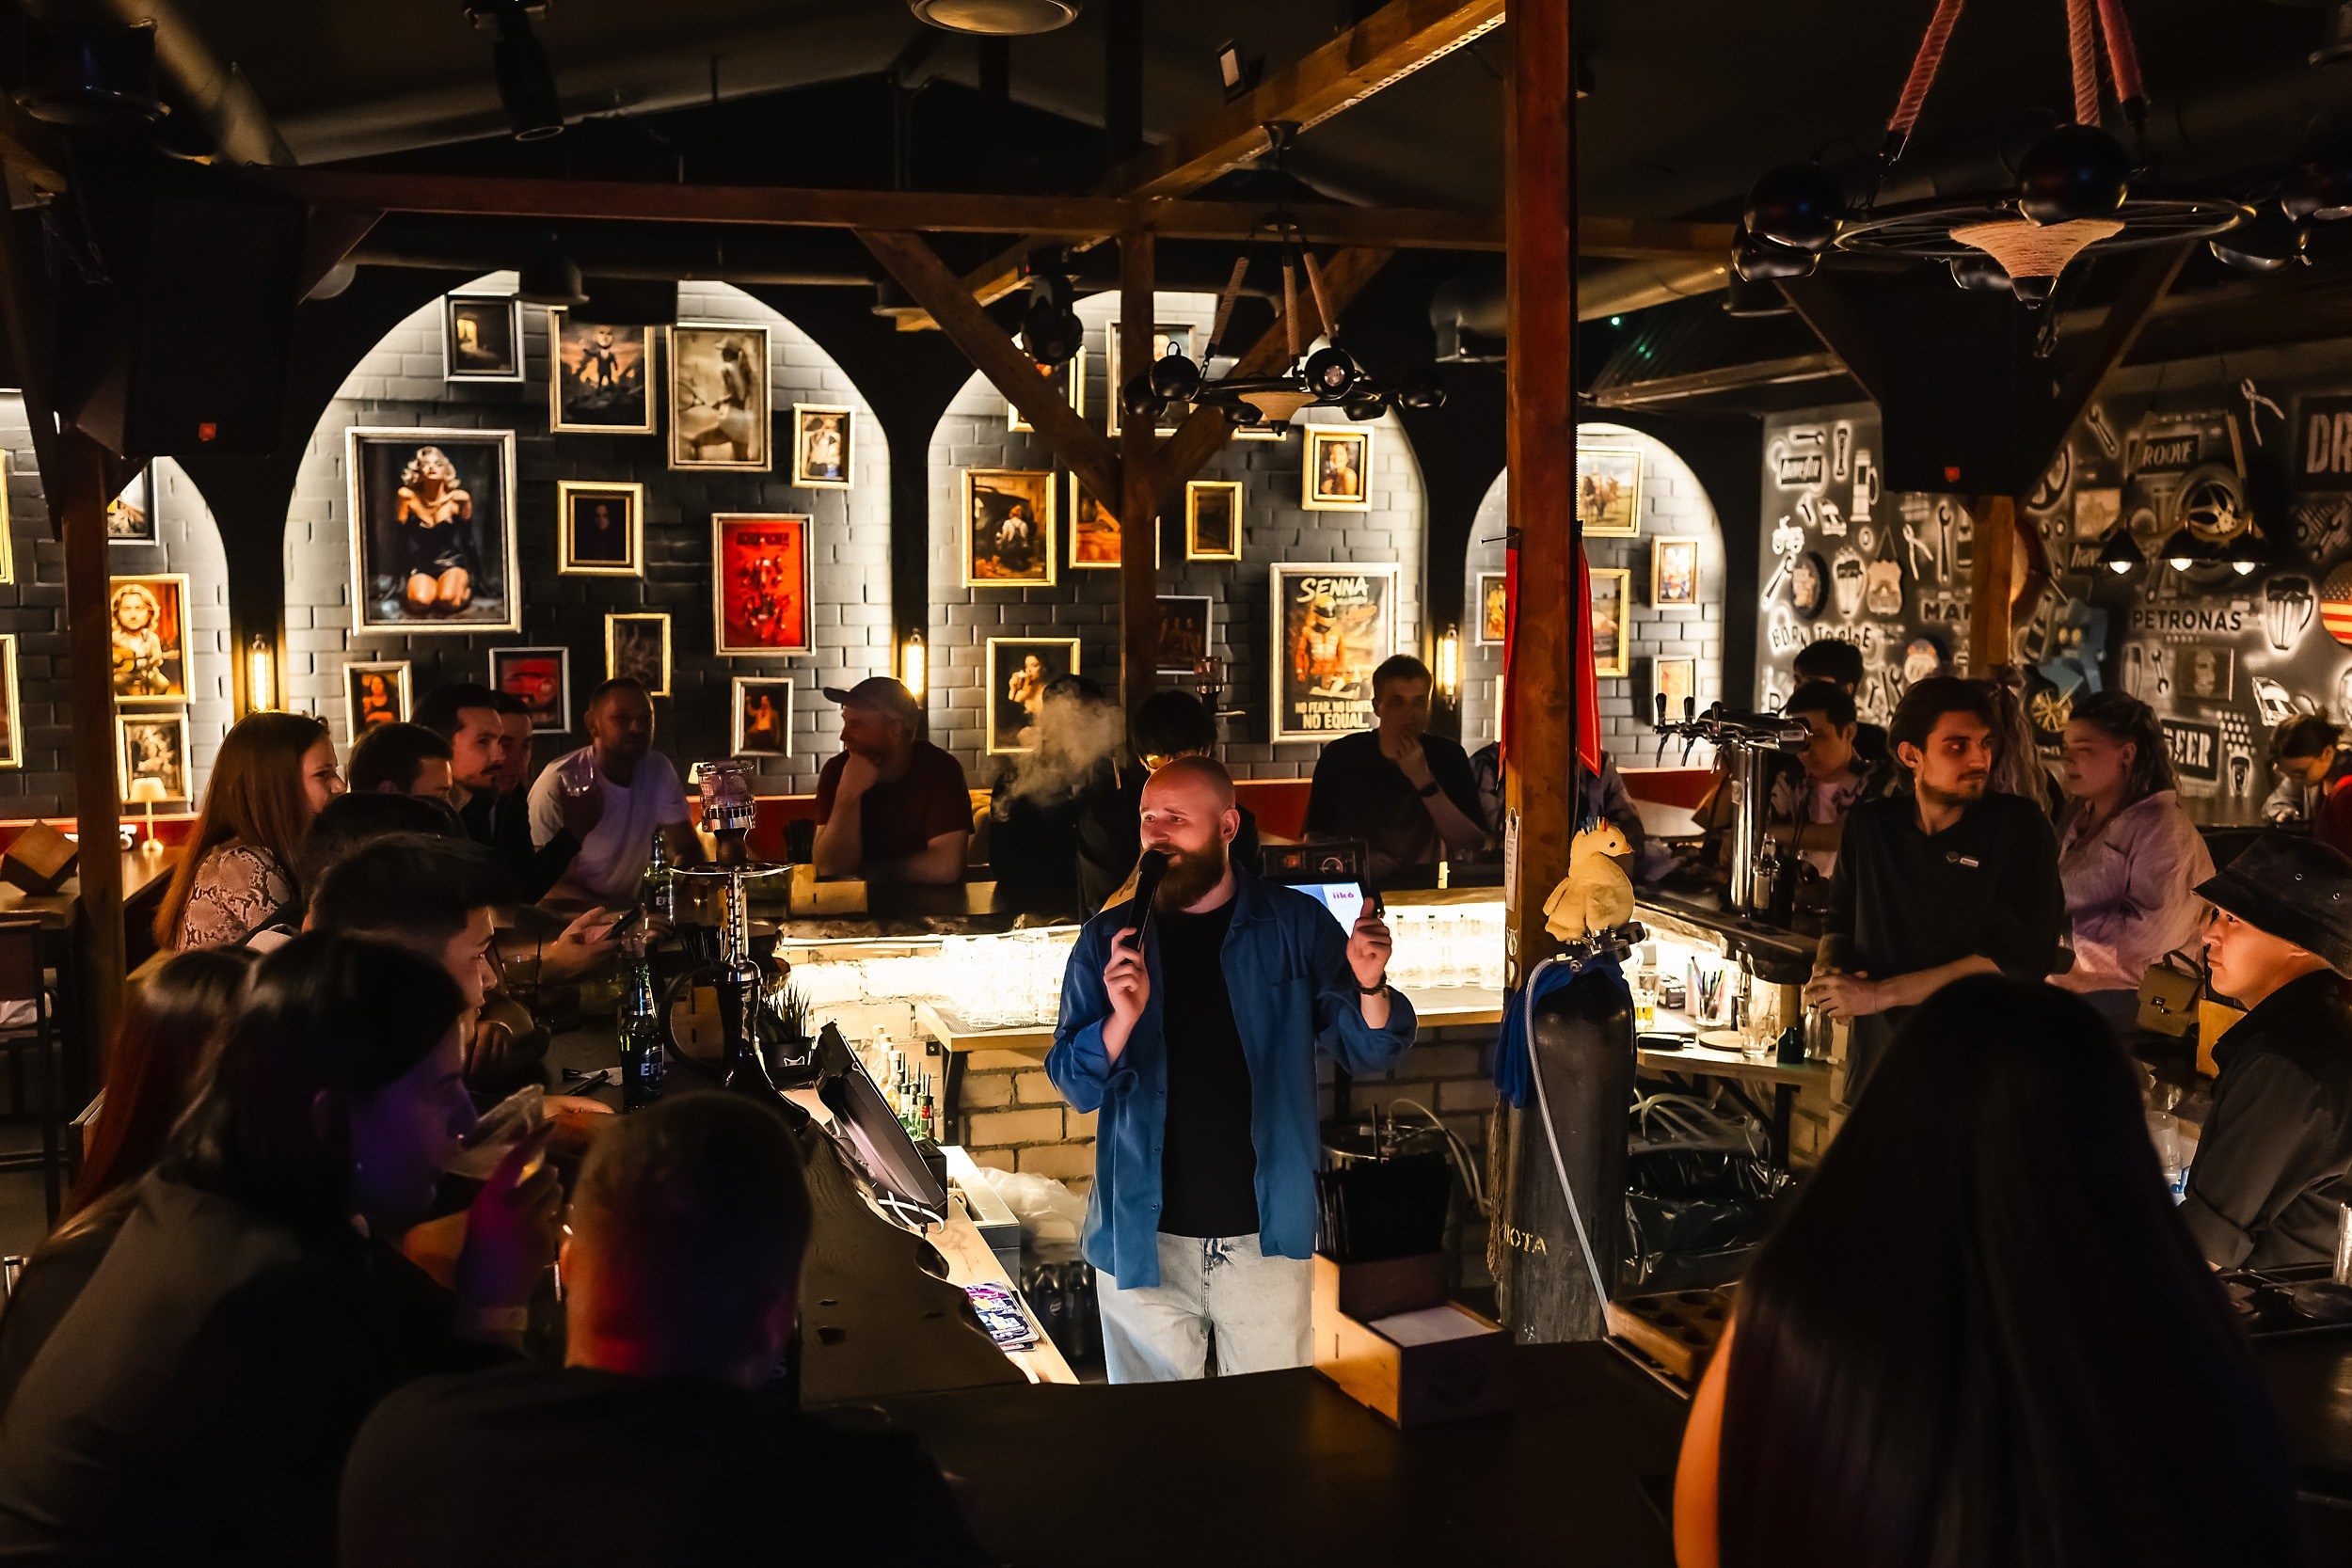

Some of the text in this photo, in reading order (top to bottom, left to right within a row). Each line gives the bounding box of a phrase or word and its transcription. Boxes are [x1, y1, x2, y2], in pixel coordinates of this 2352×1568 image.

[1296, 577, 1369, 603] SENNA
[2132, 610, 2241, 631] PETRONAS
[1332, 701, 1345, 713] NO
[1302, 713, 1322, 729] NO
